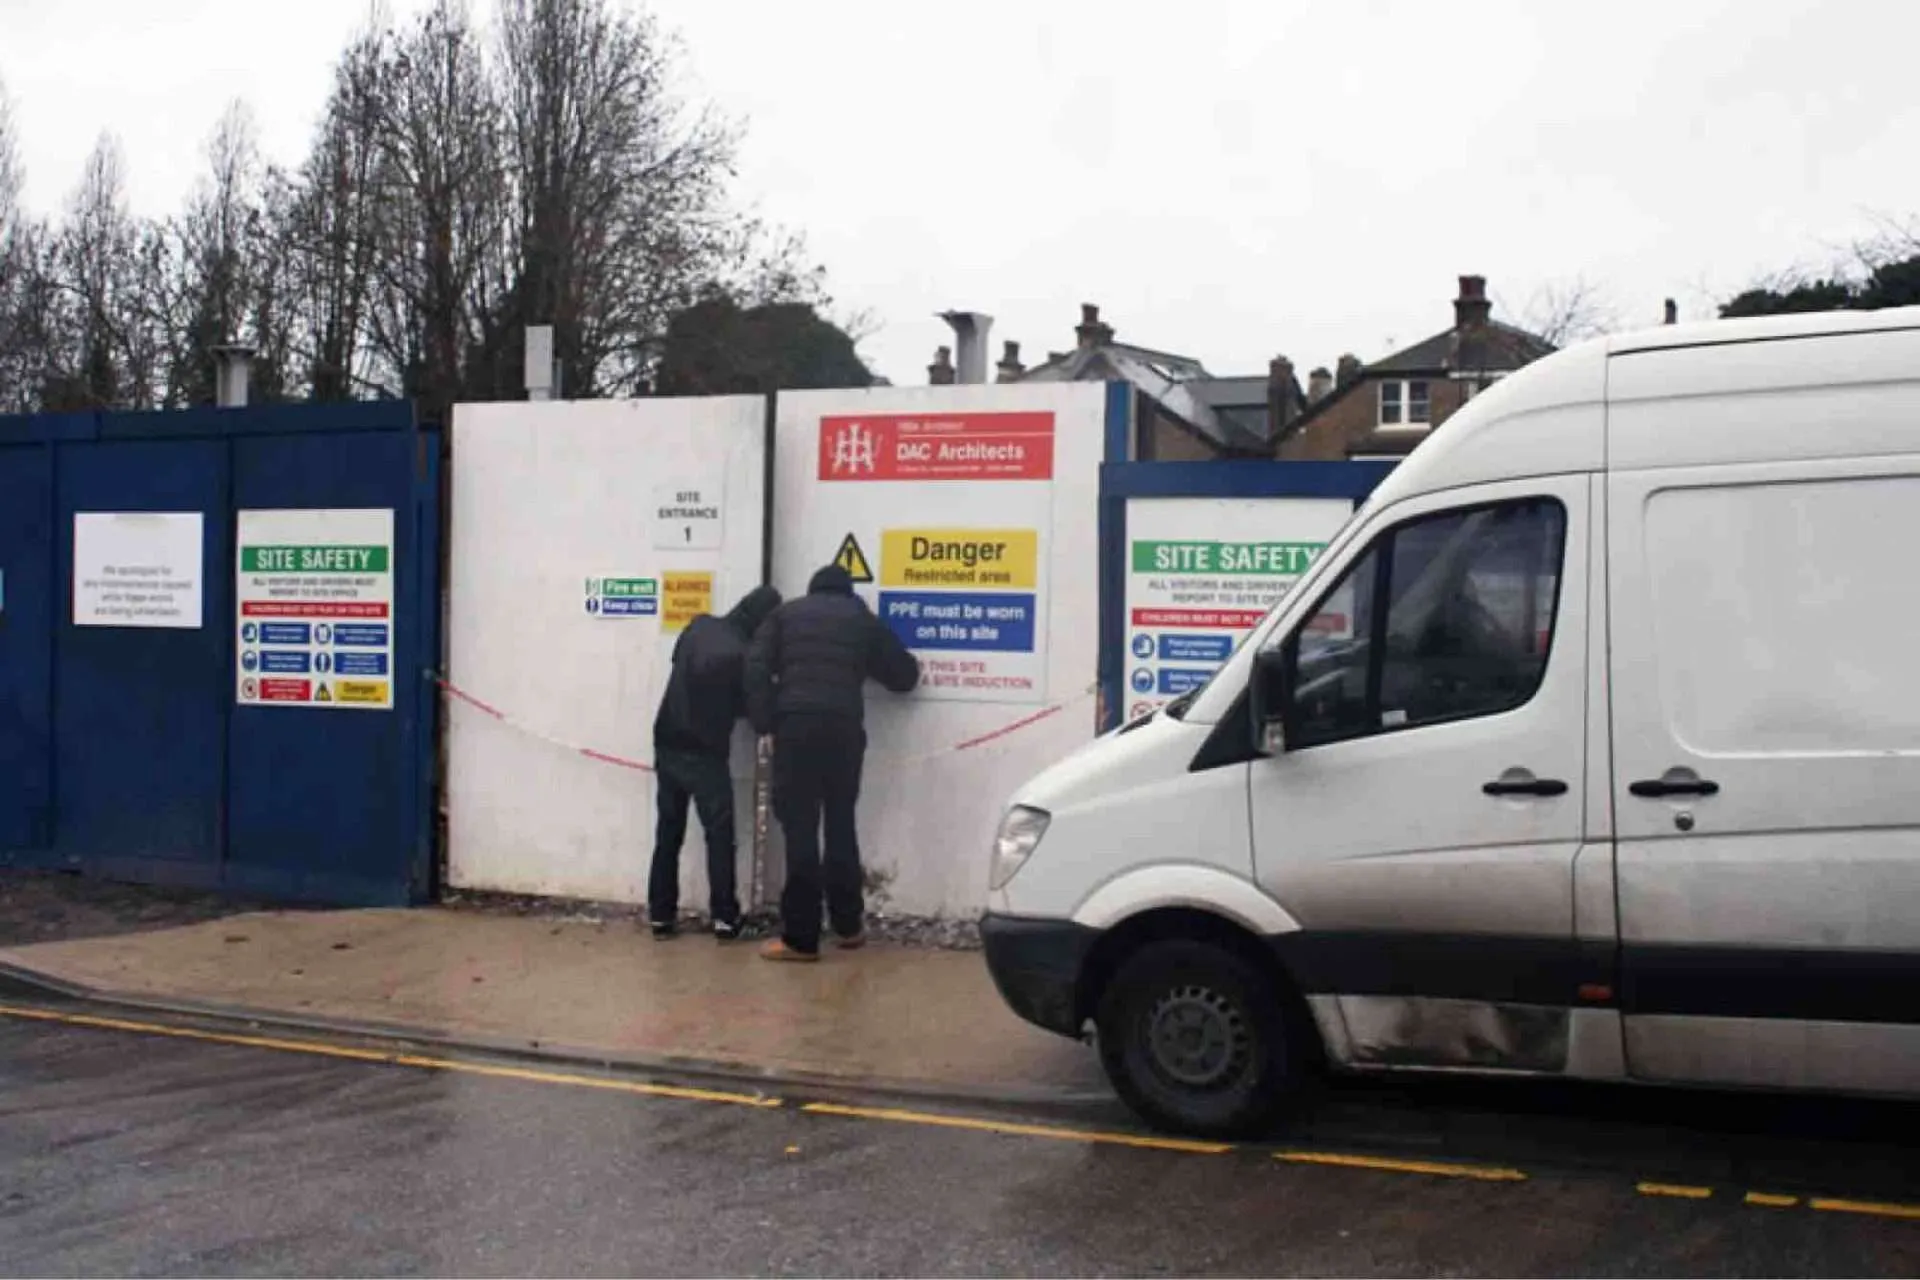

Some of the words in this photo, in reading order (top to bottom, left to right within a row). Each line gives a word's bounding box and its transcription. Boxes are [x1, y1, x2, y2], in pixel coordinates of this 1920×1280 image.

[896, 443, 930, 461] DAC
[938, 441, 1024, 460] Architects
[676, 491, 701, 503] SITE
[658, 507, 718, 519] ENTRANCE
[684, 526, 692, 542] 1
[911, 536, 1006, 566] Danger
[1155, 545, 1210, 569] SITE
[1219, 546, 1321, 570] SAFETY
[256, 548, 295, 570] SITE
[301, 549, 370, 570] SAFETY
[904, 569, 975, 583] Restricted
[979, 571, 1011, 584] area
[606, 582, 629, 594] Fire
[1149, 580, 1166, 590] ALL
[1171, 580, 1218, 590] VISITORS
[1222, 581, 1243, 590] AND
[1173, 593, 1215, 603] REPORT
[1219, 594, 1234, 603] TO
[1236, 594, 1259, 604] SITE
[603, 601, 628, 613] Keep
[889, 602, 919, 618] PPE
[923, 604, 961, 619] must
[963, 604, 982, 619] be
[987, 606, 1025, 620] worn
[1193, 614, 1218, 624] MUST
[1220, 614, 1242, 625] NOT
[916, 627, 936, 639] on
[939, 625, 967, 640] this
[972, 625, 998, 640] site
[929, 660, 956, 673] THIS
[959, 661, 986, 673] SITE
[933, 675, 959, 687] SITE
[962, 676, 1032, 689] INDUCTION
